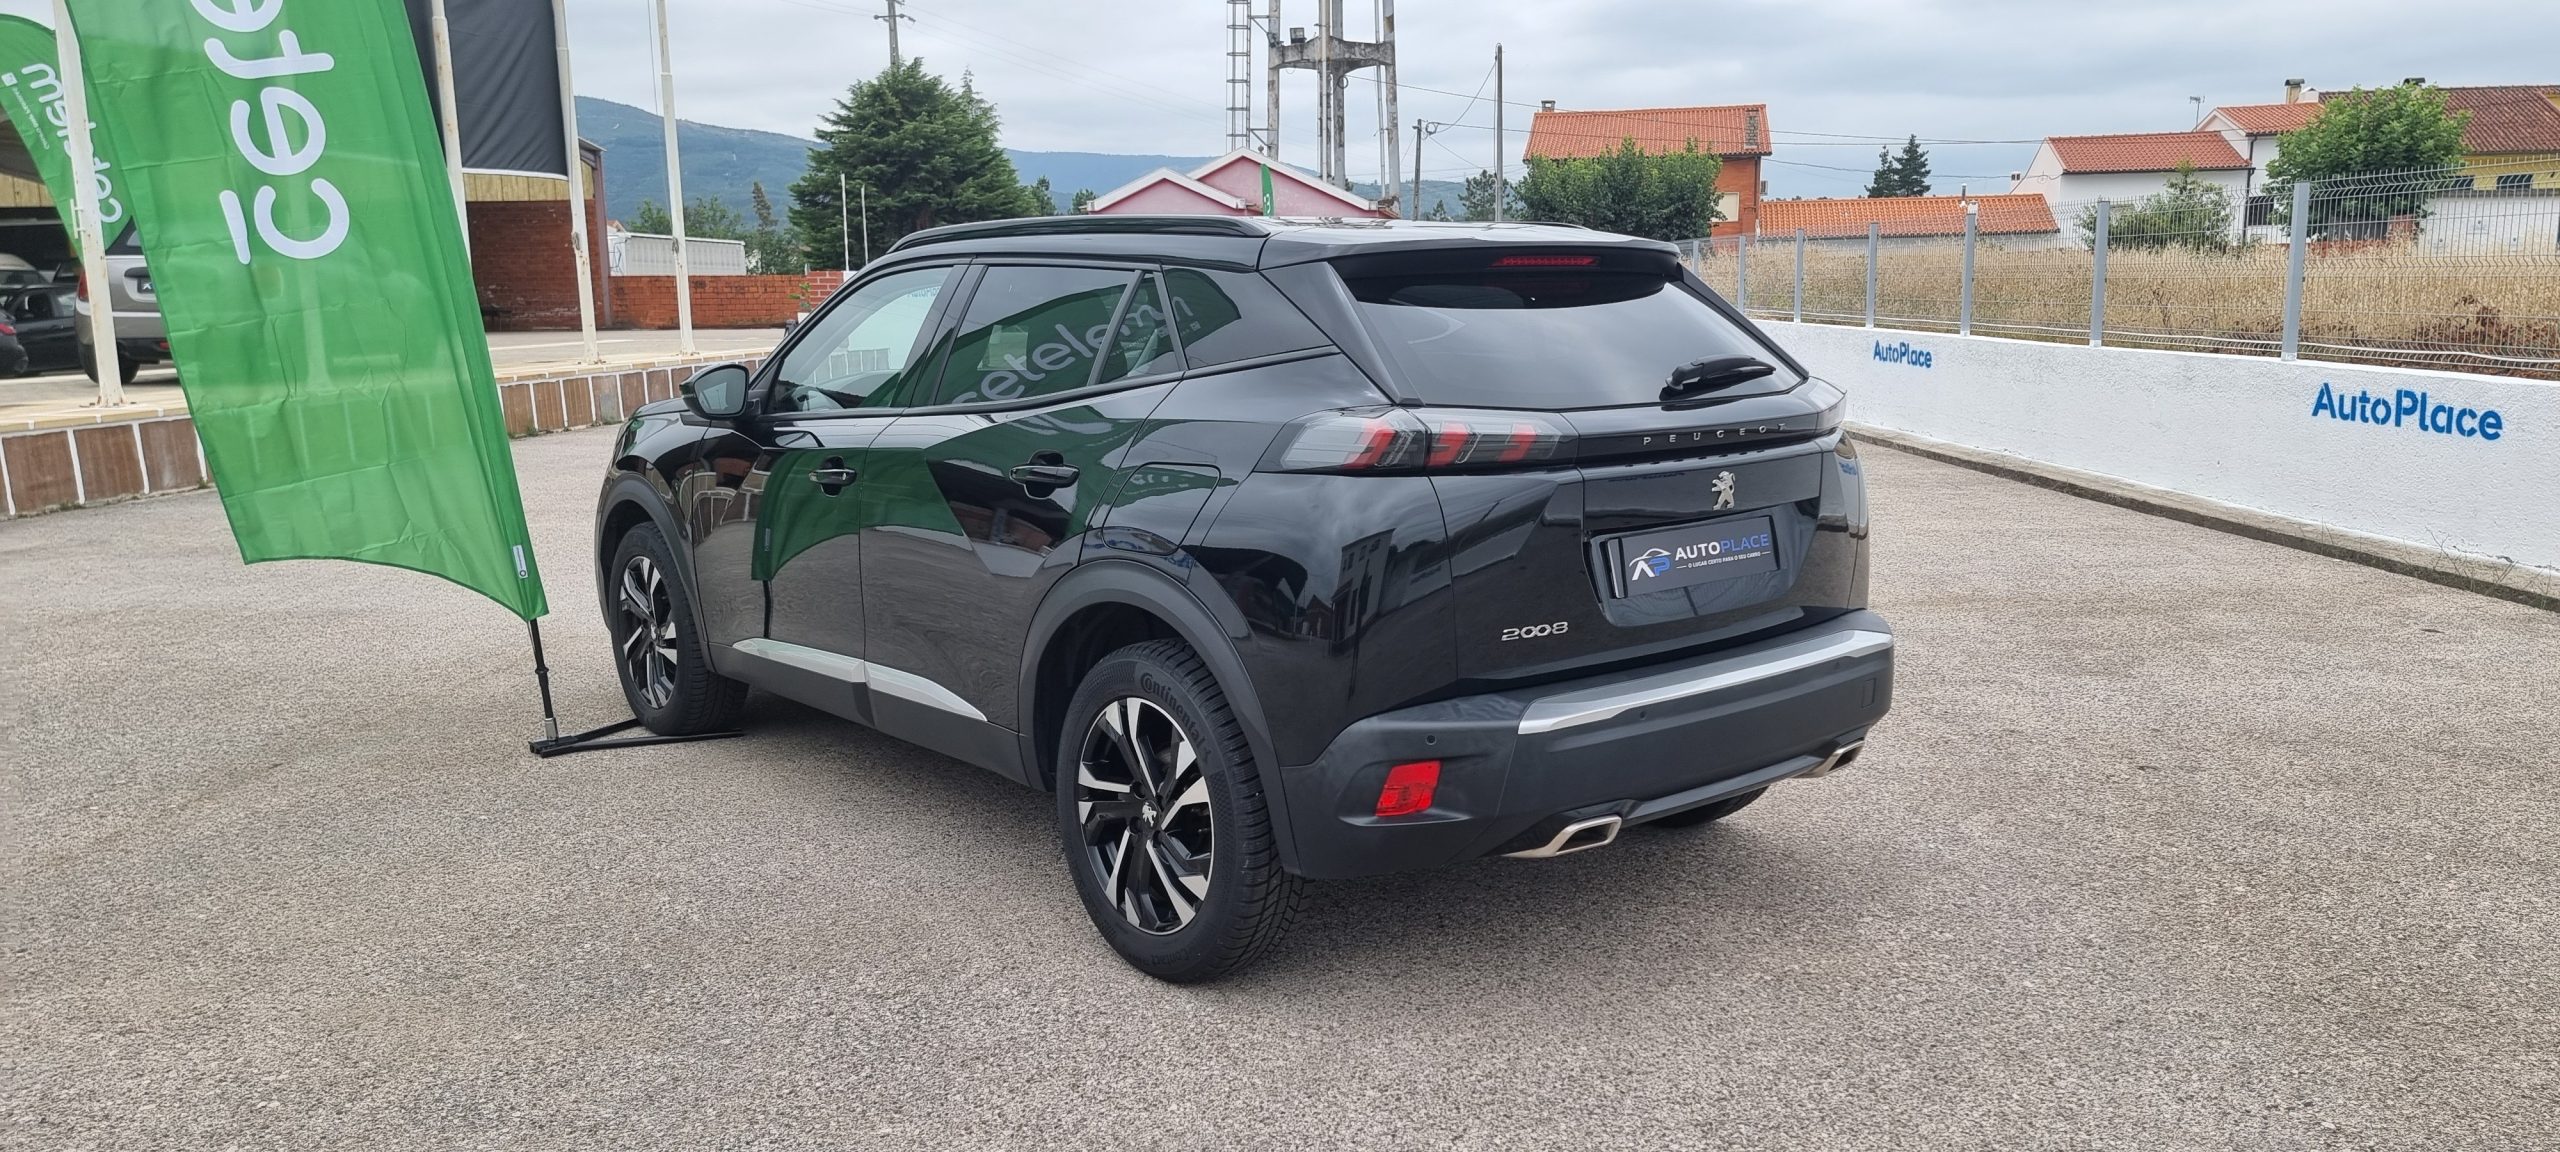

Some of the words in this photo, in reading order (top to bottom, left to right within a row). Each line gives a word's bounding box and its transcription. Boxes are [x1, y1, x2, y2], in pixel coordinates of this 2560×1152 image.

[1873, 340, 1932, 368] AutoPlace
[2311, 382, 2504, 441] AutoPlace
[1643, 423, 1786, 446] PEUGEOT
[1674, 533, 1770, 561] AUTOPLACE
[1501, 621, 1568, 641] 2008
[1140, 672, 1206, 750] Continental
